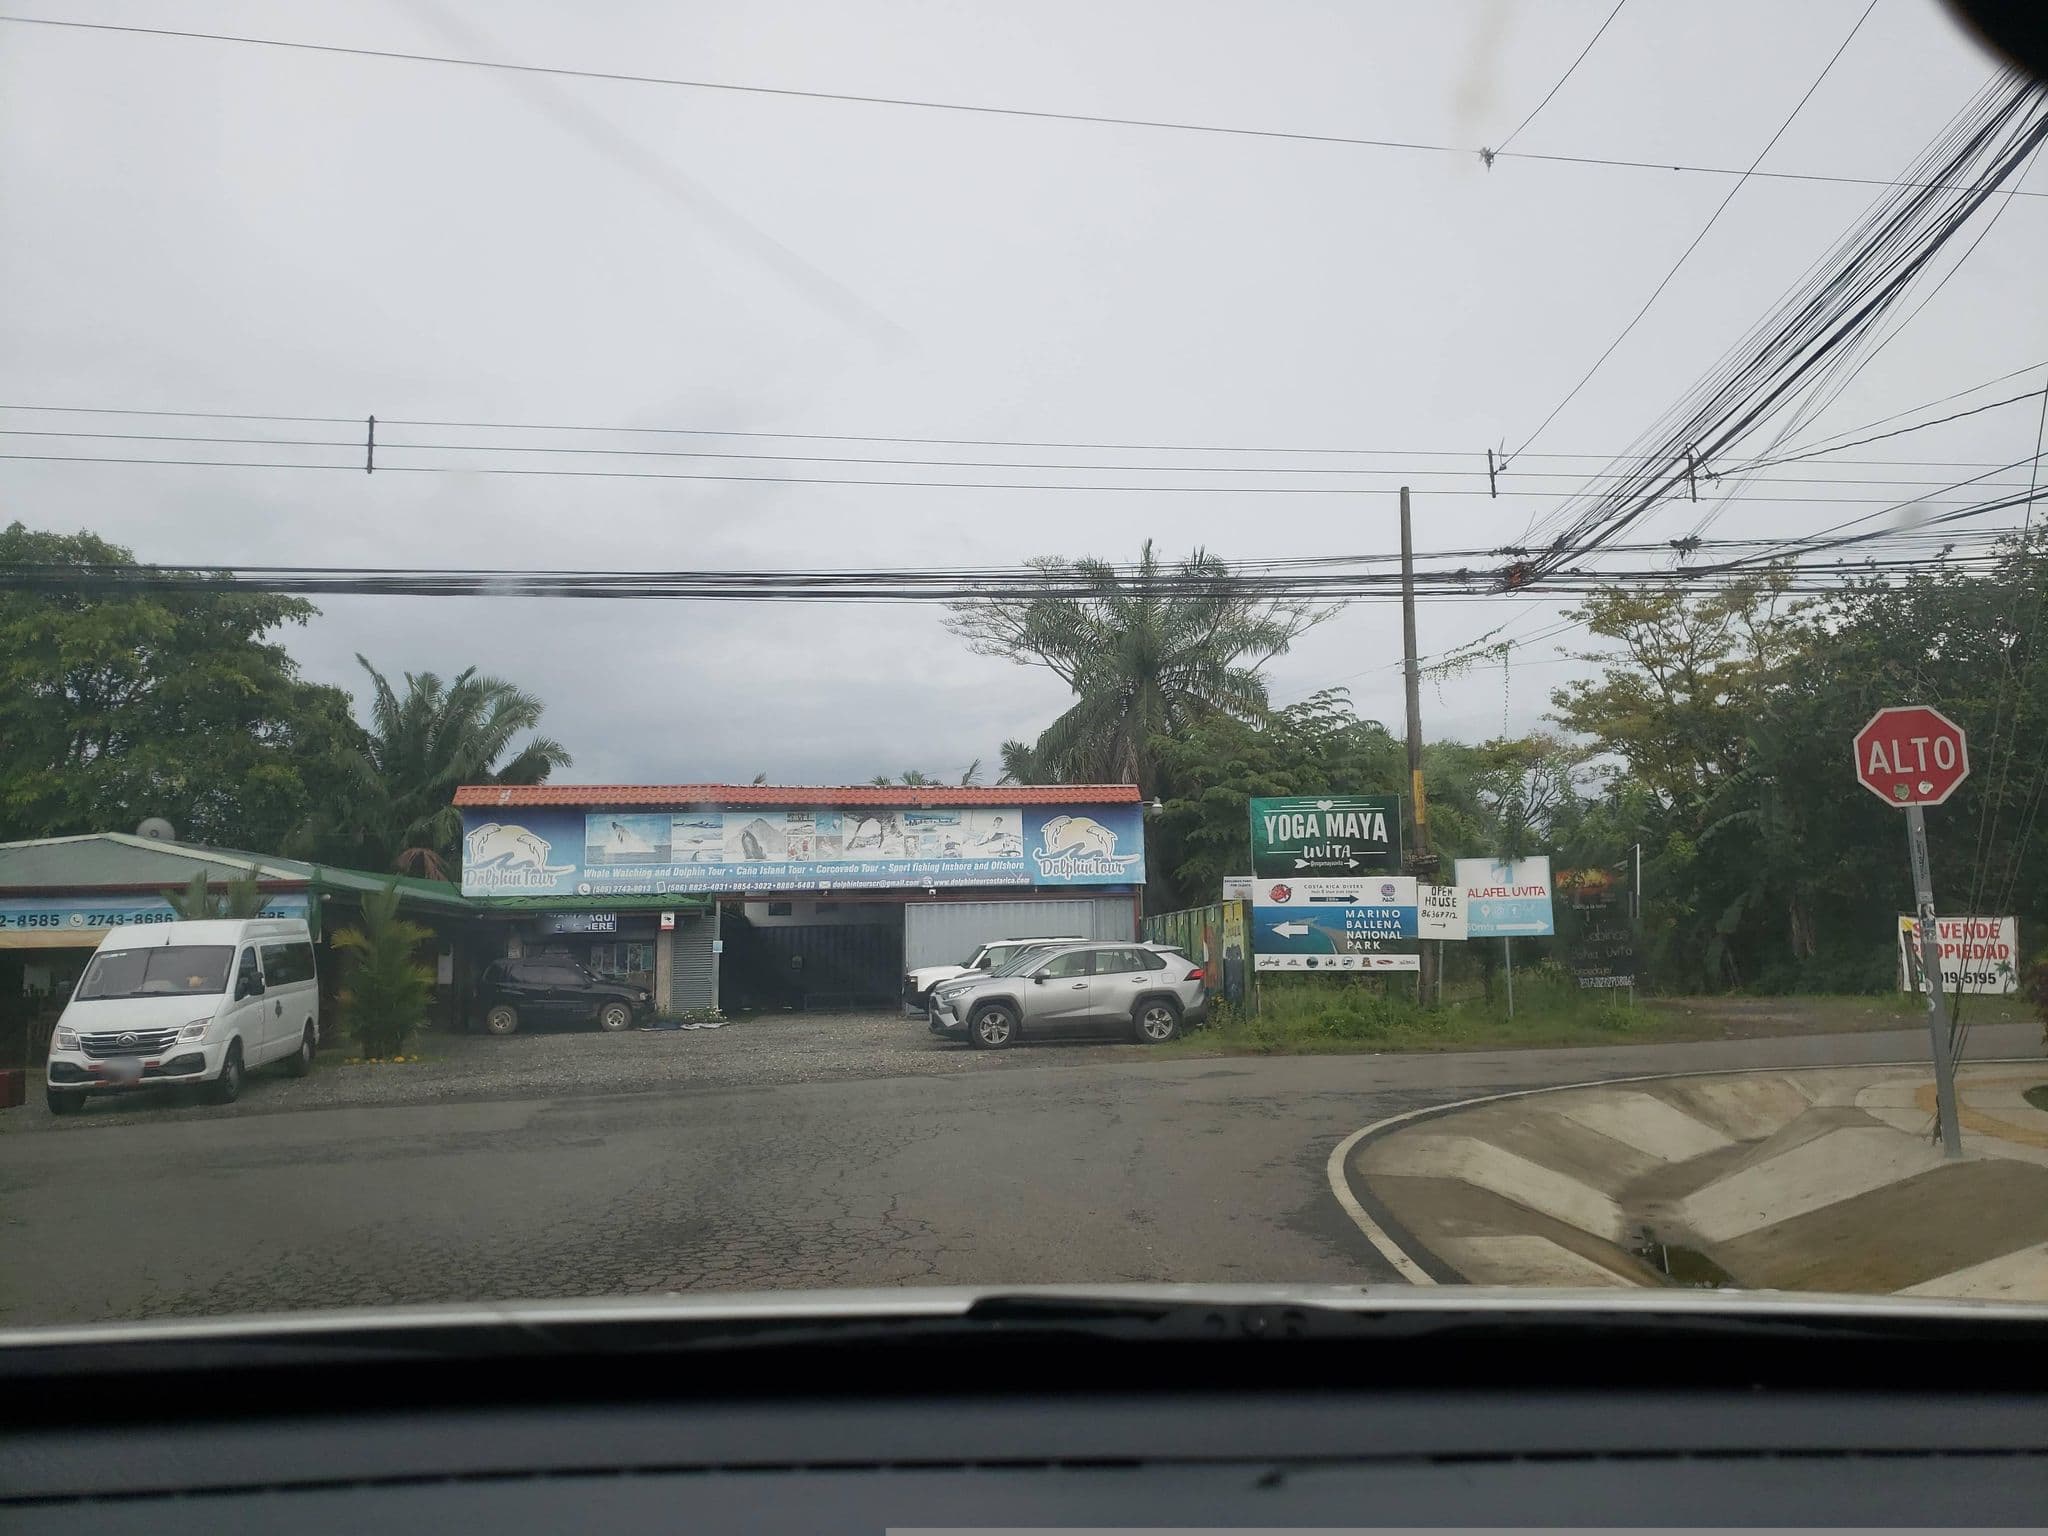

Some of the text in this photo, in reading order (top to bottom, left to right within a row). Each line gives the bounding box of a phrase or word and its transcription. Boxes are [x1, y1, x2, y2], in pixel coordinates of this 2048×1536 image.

[1868, 736, 1955, 775] ALTO
[1264, 813, 1388, 844] YOGA MAYA
[584, 869, 610, 878] Whale
[613, 868, 652, 879] Watching
[654, 868, 671, 877] and
[673, 867, 705, 878] Dolphin
[708, 866, 726, 876] Tour
[760, 866, 785, 875] Island
[789, 866, 805, 874] Tour
[816, 864, 859, 873] Corcovado
[862, 864, 878, 873] Tour
[888, 863, 911, 873] Sport
[913, 862, 939, 873] fishing
[942, 862, 972, 871] Inshore
[974, 862, 989, 870] and
[991, 861, 1024, 870] Offshore
[1041, 859, 1124, 878] Dolphin Tour
[464, 867, 556, 888] Dolphin Tour
[1432, 886, 1453, 897] OPEN
[1468, 886, 1546, 898] ALAFEL UVITA
[1425, 896, 1457, 907] HOUSE
[87, 912, 173, 926] 2743-8686
[589, 913, 615, 922] AQUI
[1345, 909, 1401, 918] MARINO
[584, 922, 614, 930] HERE
[1346, 920, 1401, 929] BALLENA
[1346, 930, 1403, 939] NATIONAL
[1939, 922, 2000, 939] VENDE
[1347, 941, 1380, 950] PARK
